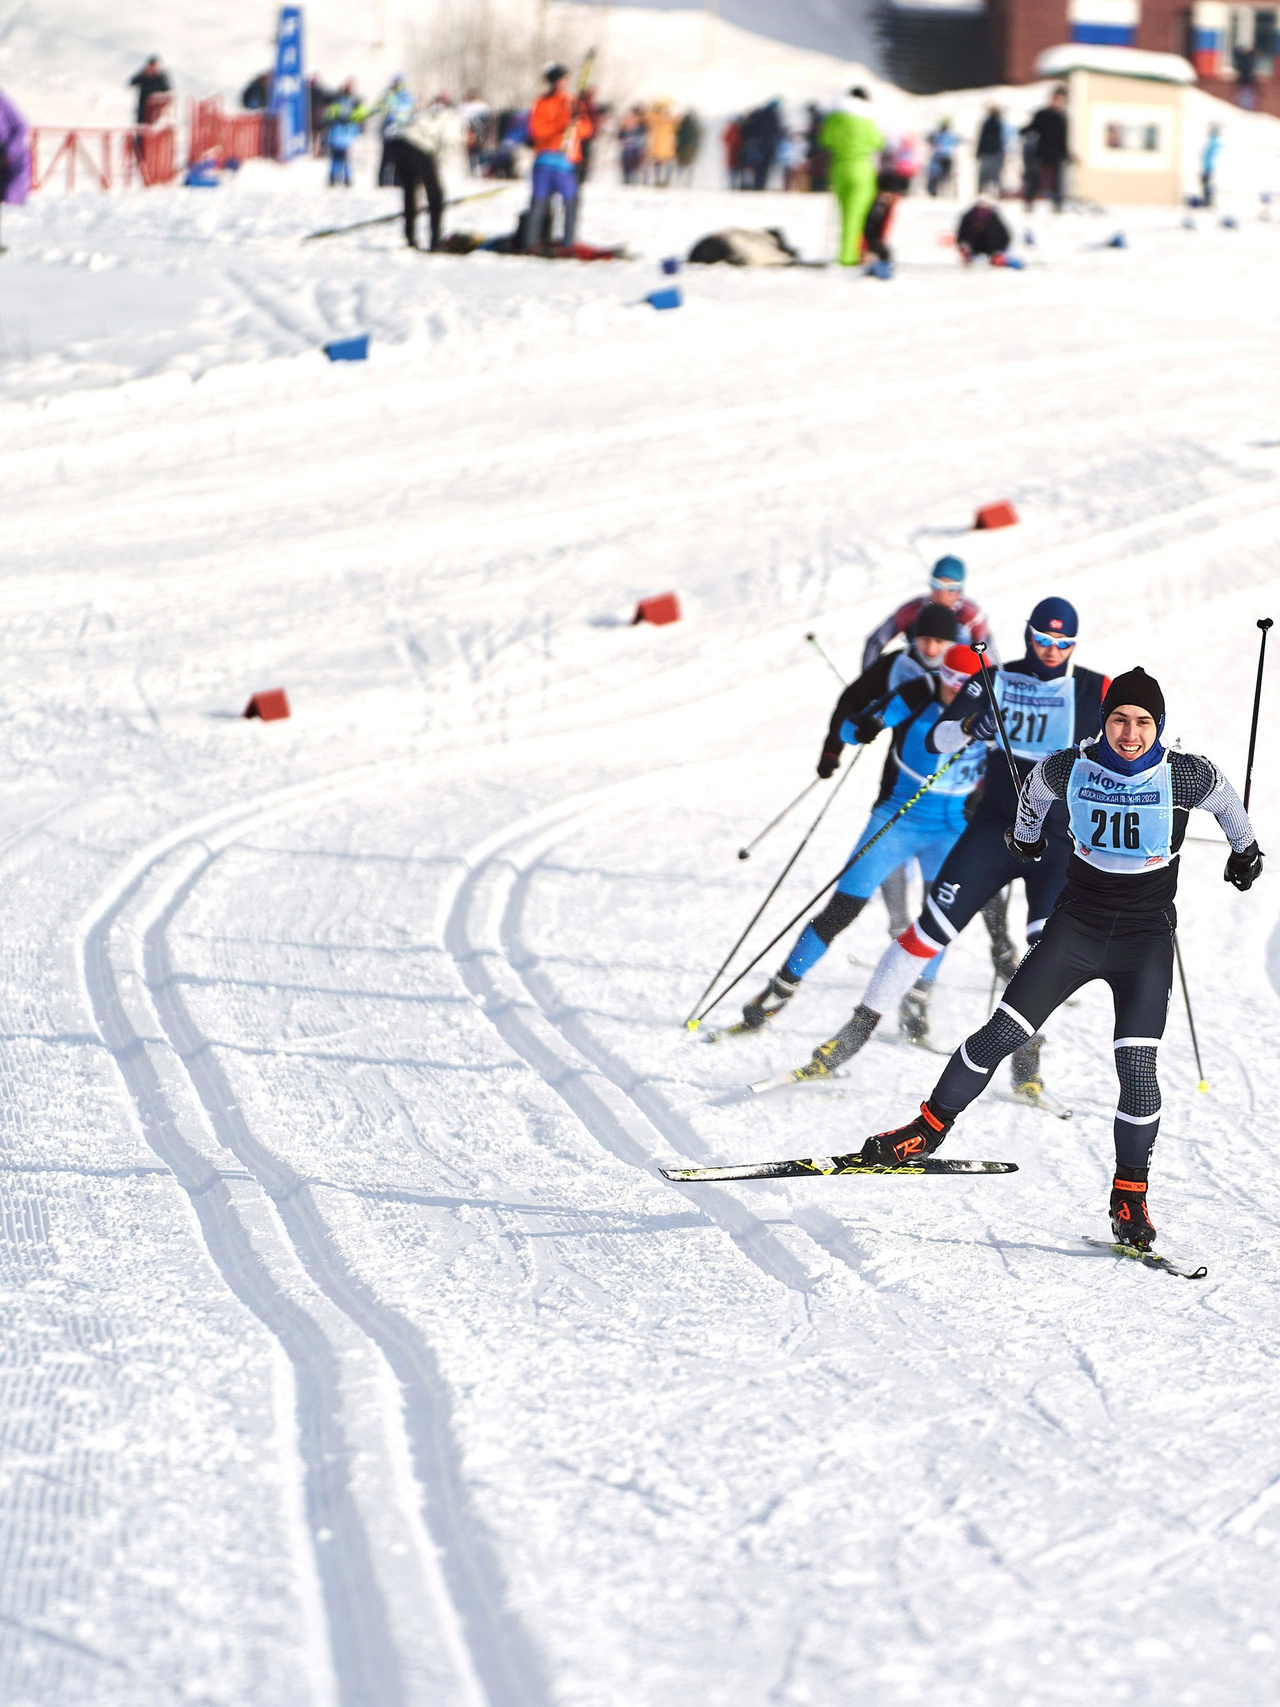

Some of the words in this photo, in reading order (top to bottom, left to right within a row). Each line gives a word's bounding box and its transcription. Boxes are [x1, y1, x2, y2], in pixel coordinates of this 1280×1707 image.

[1009, 710, 1048, 743] 217
[1087, 769, 1128, 791] МФП
[1080, 789, 1119, 803] МОСКОВСКАЯ
[1119, 794, 1141, 803] ЛЫЖНЯ
[1141, 793, 1157, 803] 2022
[1091, 809, 1140, 849] 216
[838, 1166, 926, 1175] FISCHER
